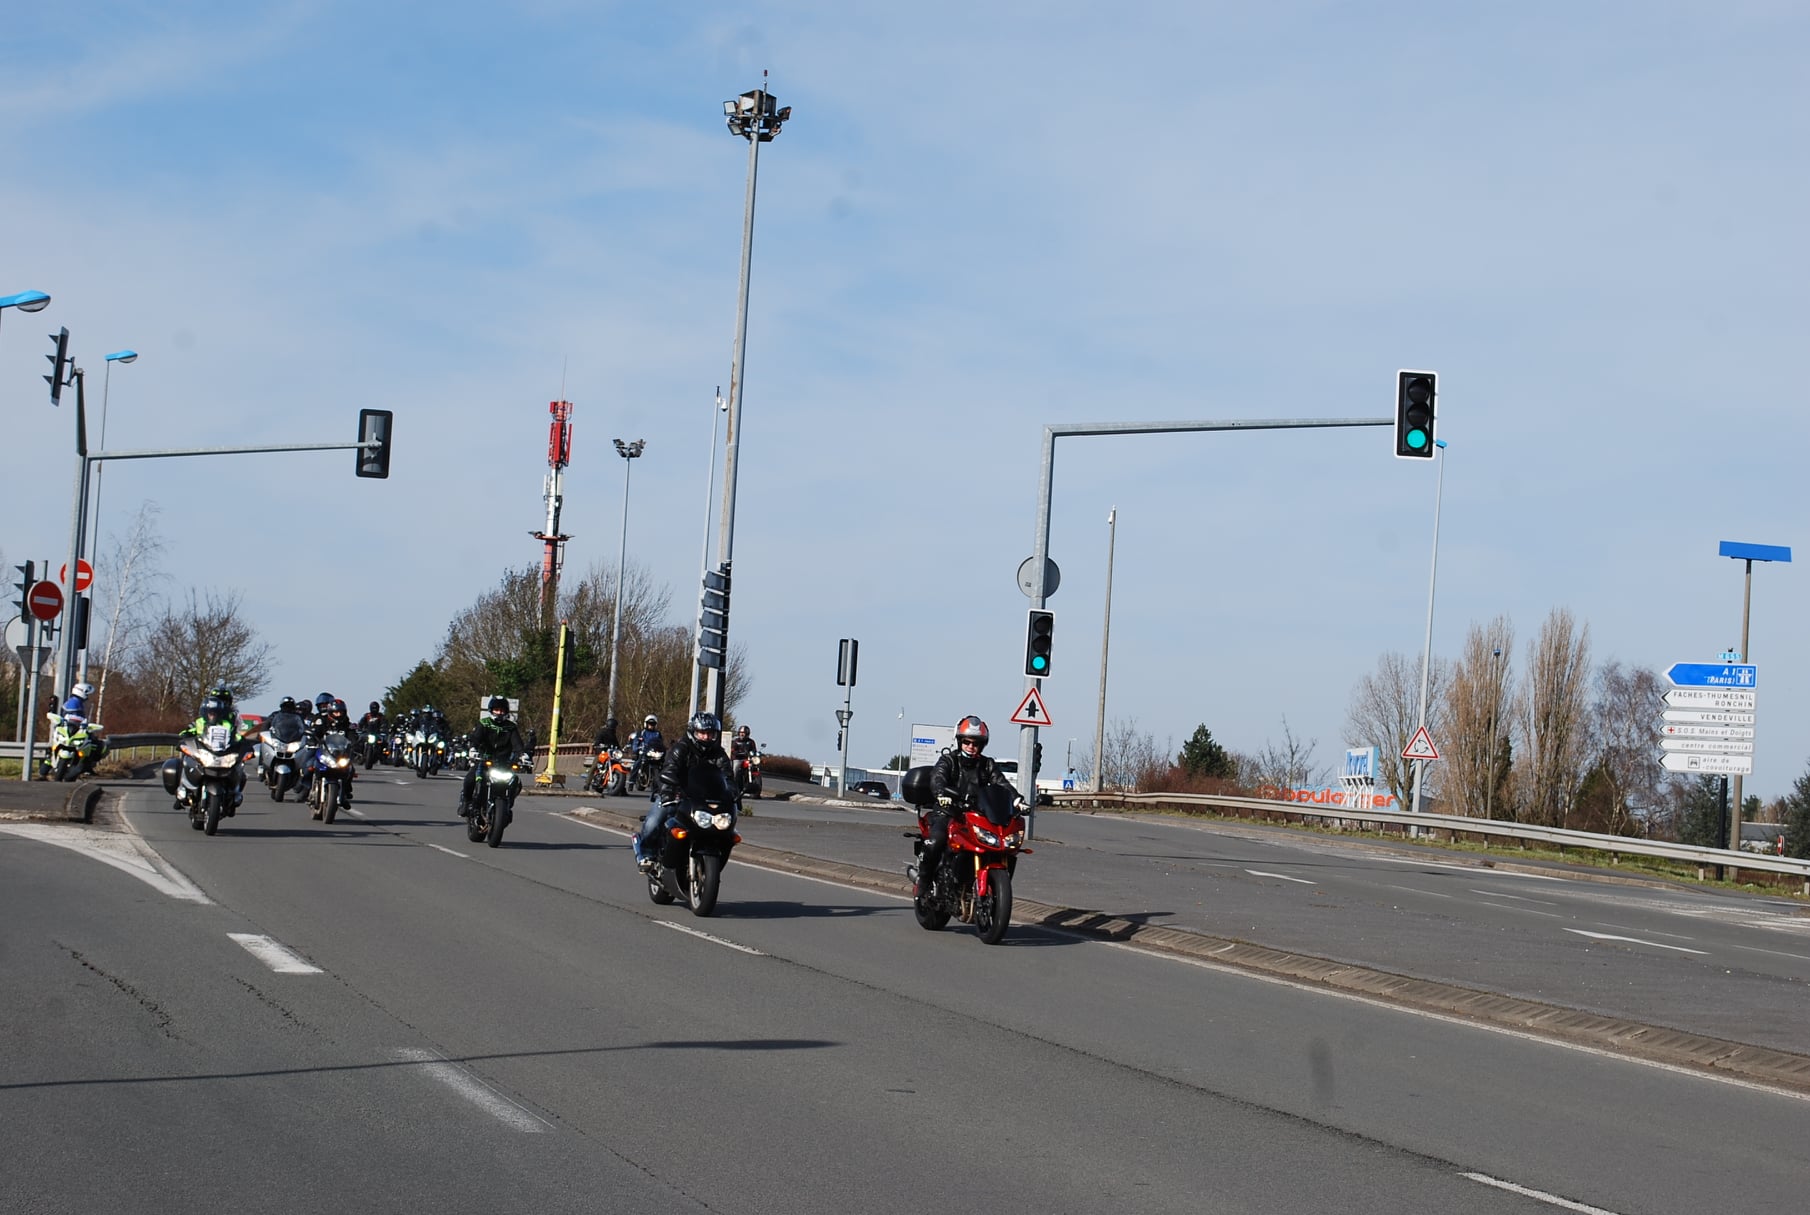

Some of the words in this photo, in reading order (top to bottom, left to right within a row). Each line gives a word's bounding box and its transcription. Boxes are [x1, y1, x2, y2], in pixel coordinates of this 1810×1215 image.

[1722, 668, 1729, 676] A
[1673, 691, 1753, 701] FACHES-THUMESNIL
[1700, 713, 1753, 722] VENDEVILLE
[1730, 729, 1752, 737] Doigts
[1283, 785, 1397, 808] boulaer
